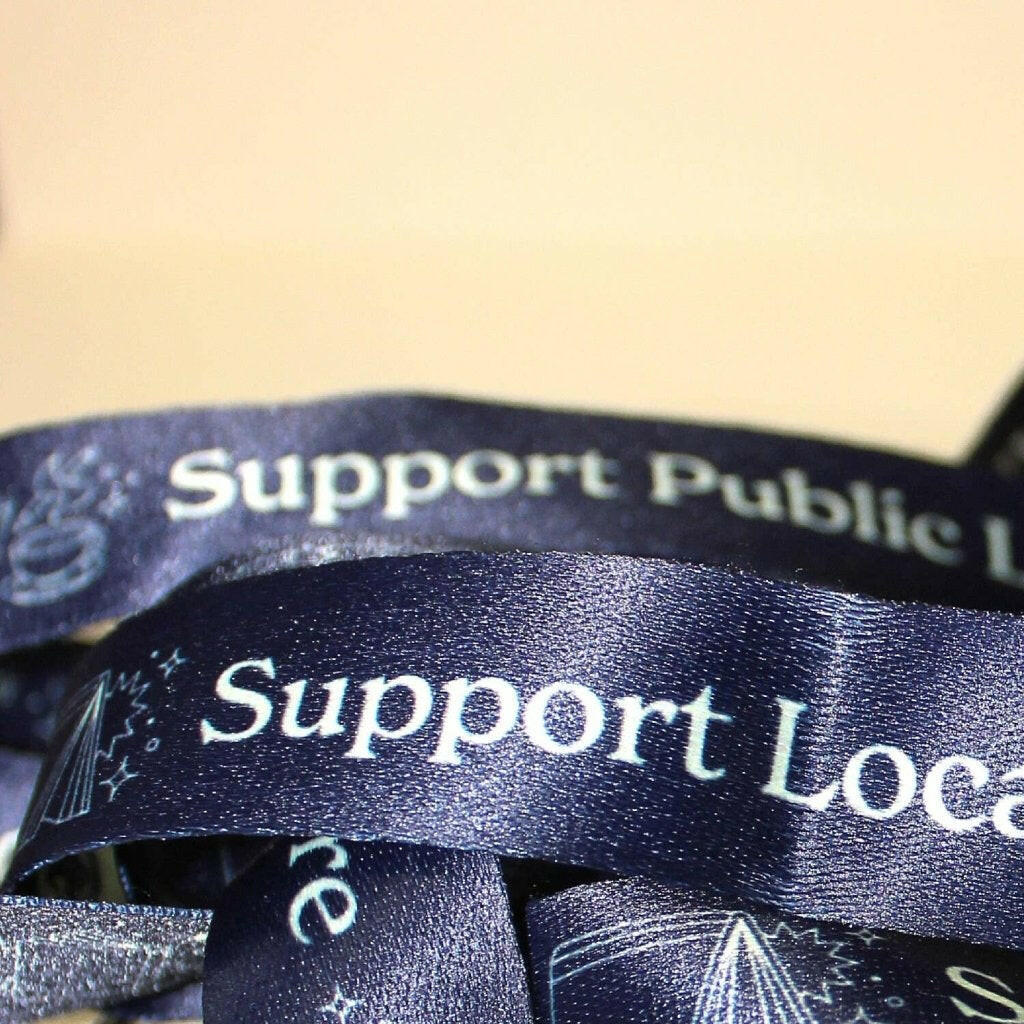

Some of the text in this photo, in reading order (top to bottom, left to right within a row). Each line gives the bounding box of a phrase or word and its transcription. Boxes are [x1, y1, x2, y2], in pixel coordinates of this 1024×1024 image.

[164, 446, 619, 526] Support
[648, 452, 963, 566] Public
[200, 657, 734, 781] Support
